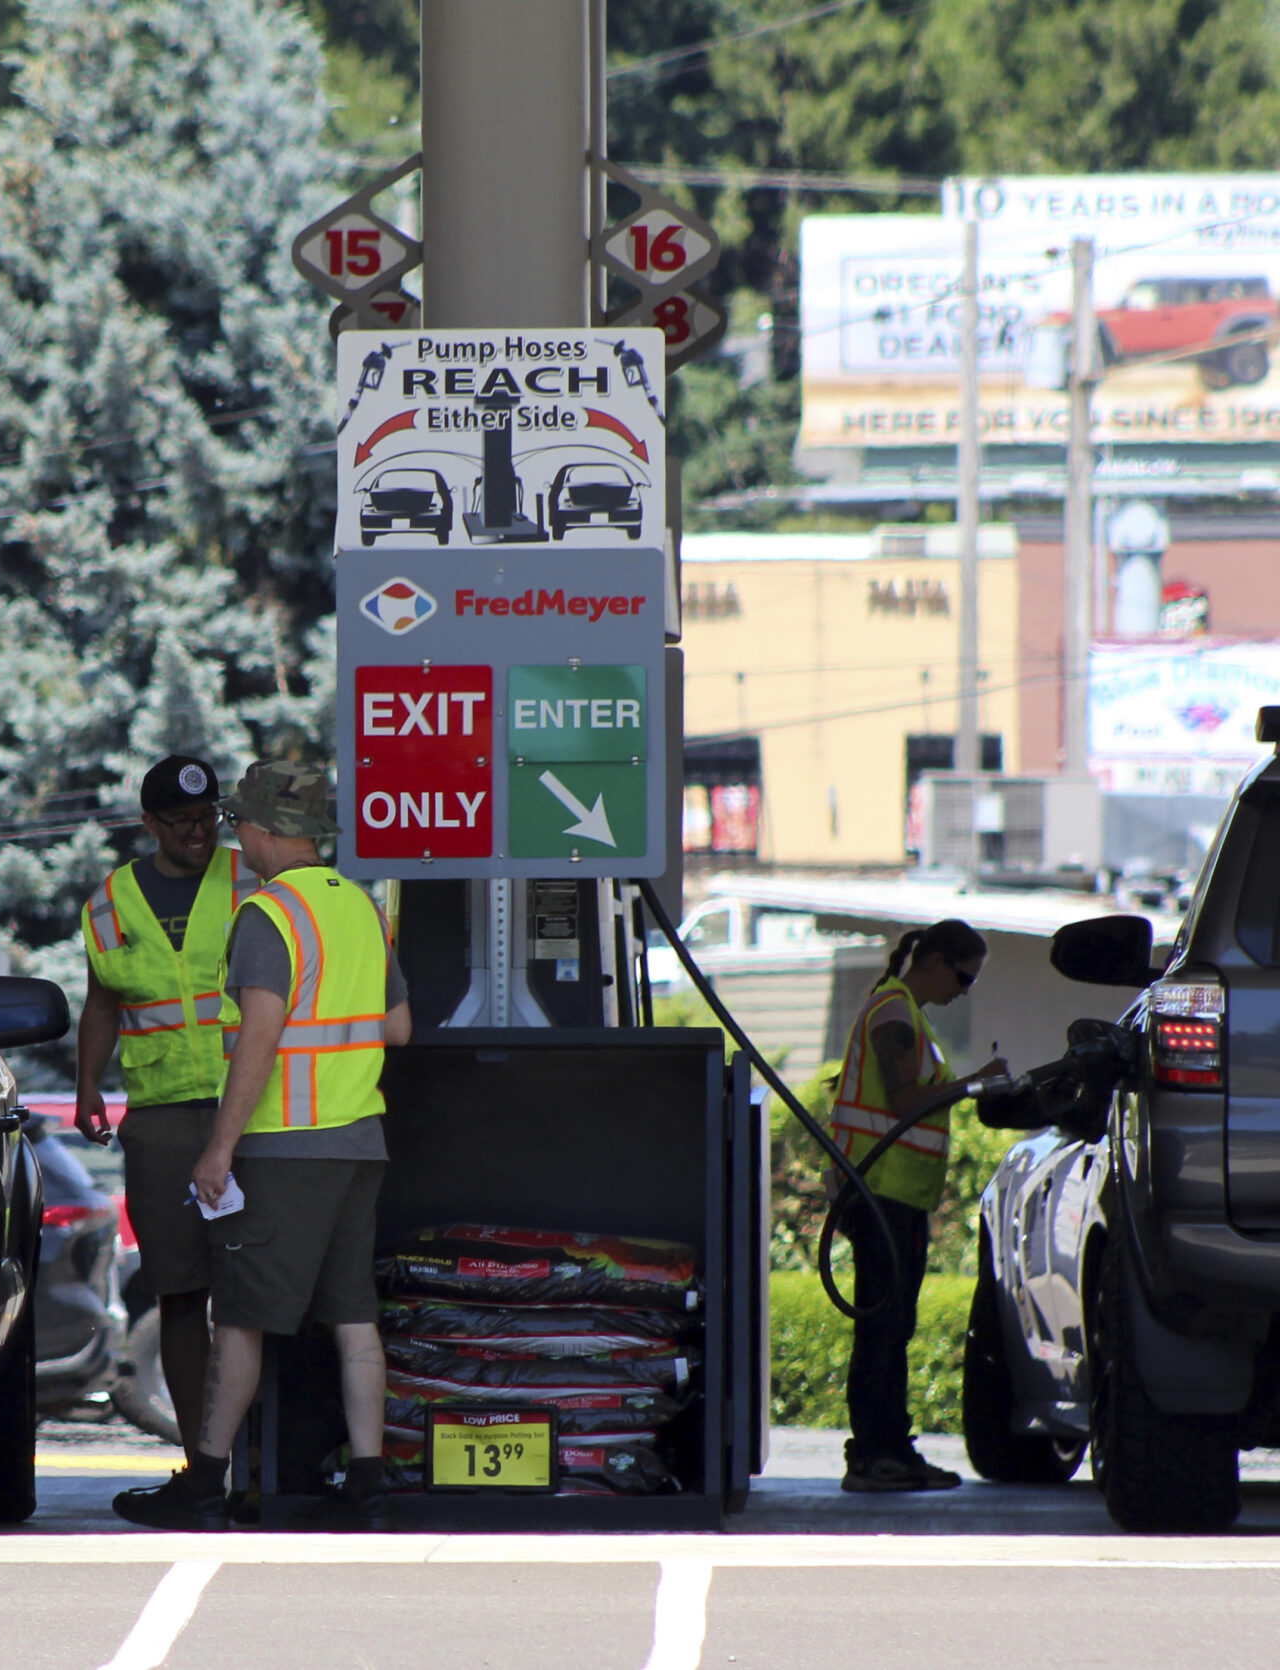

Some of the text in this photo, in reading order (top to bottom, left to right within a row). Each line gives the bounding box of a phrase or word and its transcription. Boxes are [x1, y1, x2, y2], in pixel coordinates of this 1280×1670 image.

[1021, 190, 1141, 218] YEARS
[1152, 191, 1186, 217] IN
[1197, 190, 1221, 217] A
[325, 229, 381, 276] 15
[629, 225, 687, 271] 16
[653, 296, 690, 345] 8
[418, 336, 586, 364] Pump Hoses
[402, 366, 609, 396] REACH
[427, 405, 577, 430] Either Side
[842, 411, 937, 435] HERE
[1110, 406, 1218, 431] SINCE
[455, 589, 646, 623] FredMeyer
[362, 692, 486, 736] EXIT
[514, 699, 641, 729] ENTER
[362, 791, 486, 829] ONLY
[463, 1413, 520, 1425] LOW PRICE
